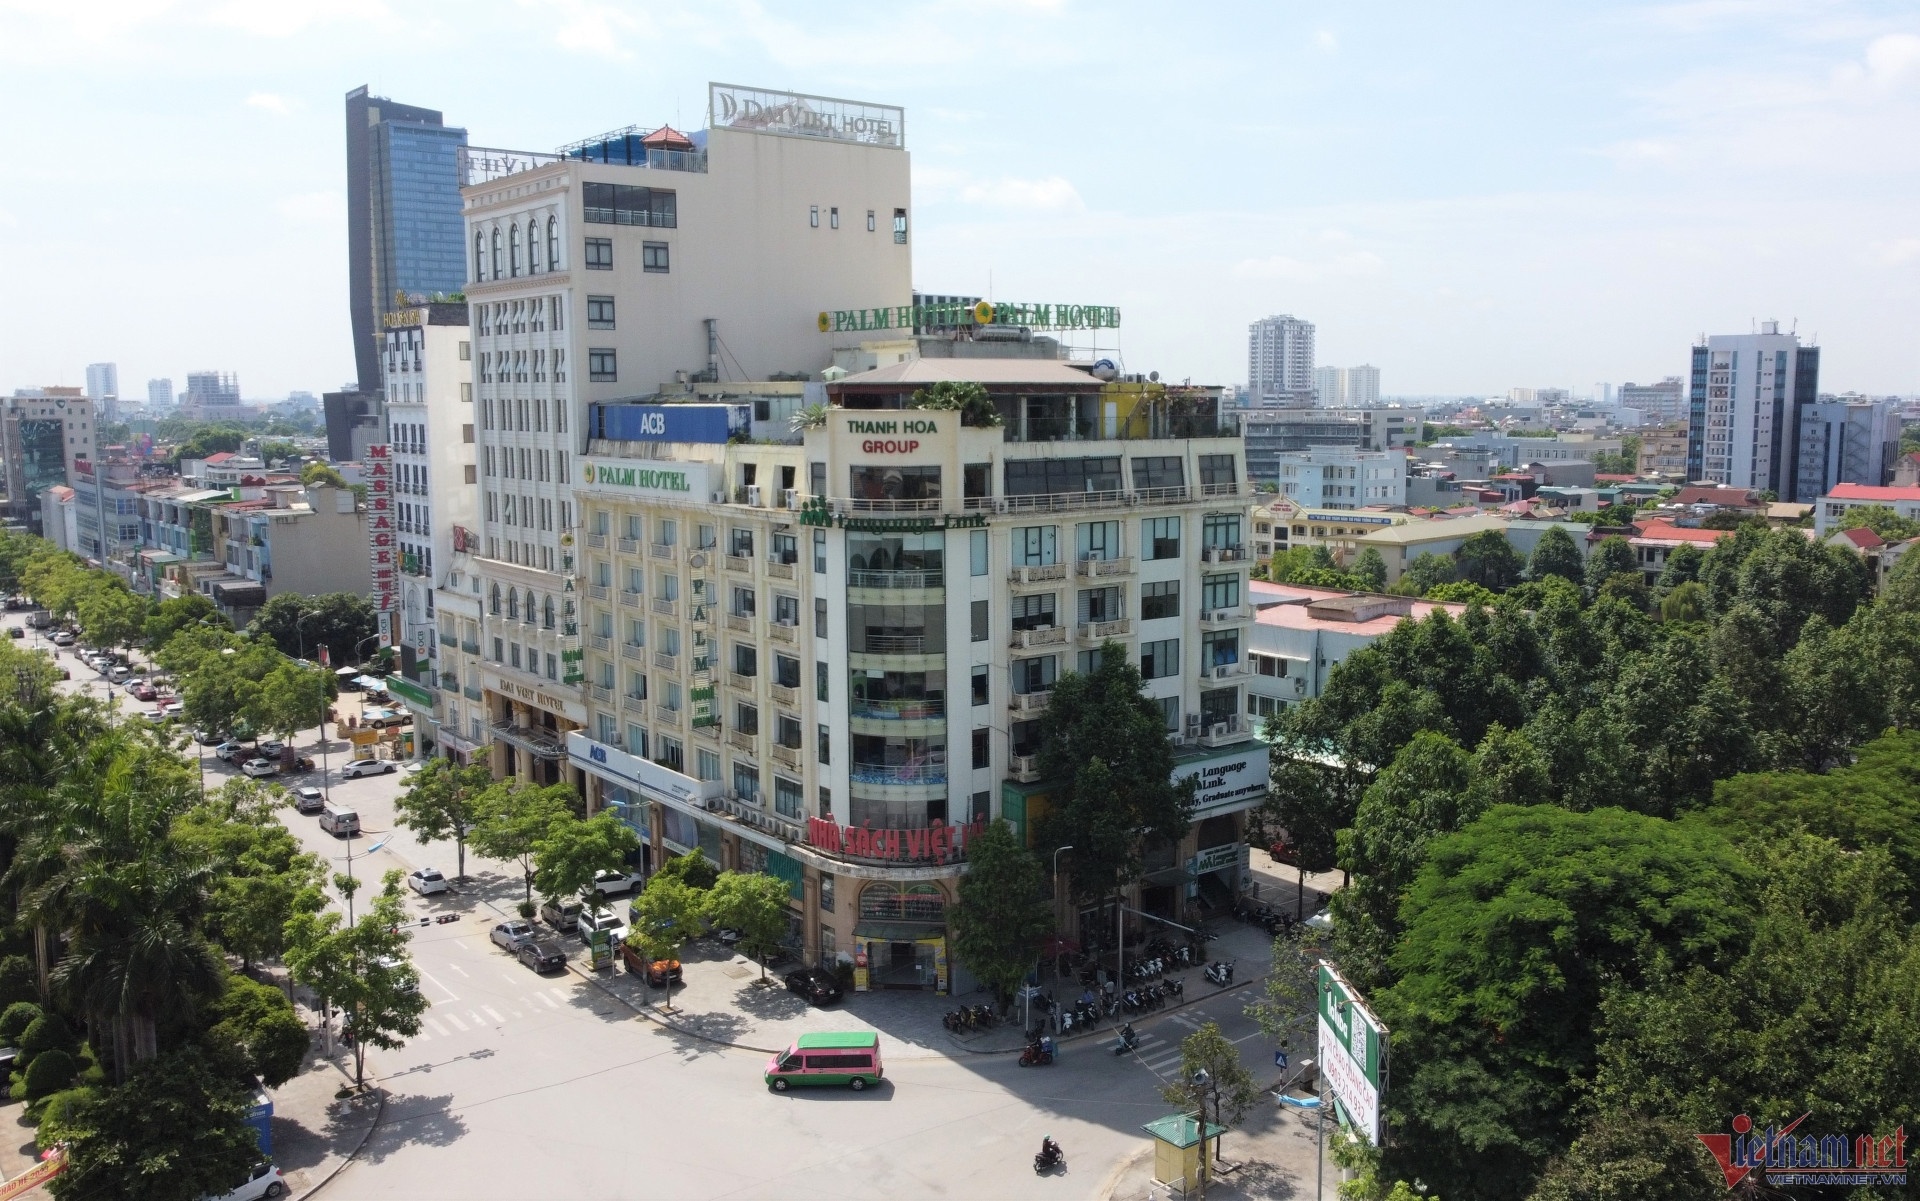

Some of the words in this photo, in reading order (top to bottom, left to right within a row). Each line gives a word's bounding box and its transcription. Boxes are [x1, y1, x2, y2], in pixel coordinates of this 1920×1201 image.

[835, 308, 890, 332] PALM
[896, 302, 974, 328] HOTEL
[995, 302, 1051, 326] PALM
[1054, 304, 1120, 328] HOTEL
[640, 413, 665, 435] ACB
[847, 420, 897, 434] THANH
[903, 420, 938, 434] HOA
[862, 440, 919, 454] GROUP
[598, 466, 636, 486] PALM
[638, 469, 690, 492] HOTEL
[370, 445, 391, 564] MASSAGE
[838, 513, 936, 535] Language
[589, 744, 607, 764] ACB
[1202, 761, 1247, 778] Language
[808, 812, 841, 853] NHÀ
[844, 818, 900, 859] SÁCH
[906, 817, 957, 866] VIỆT
